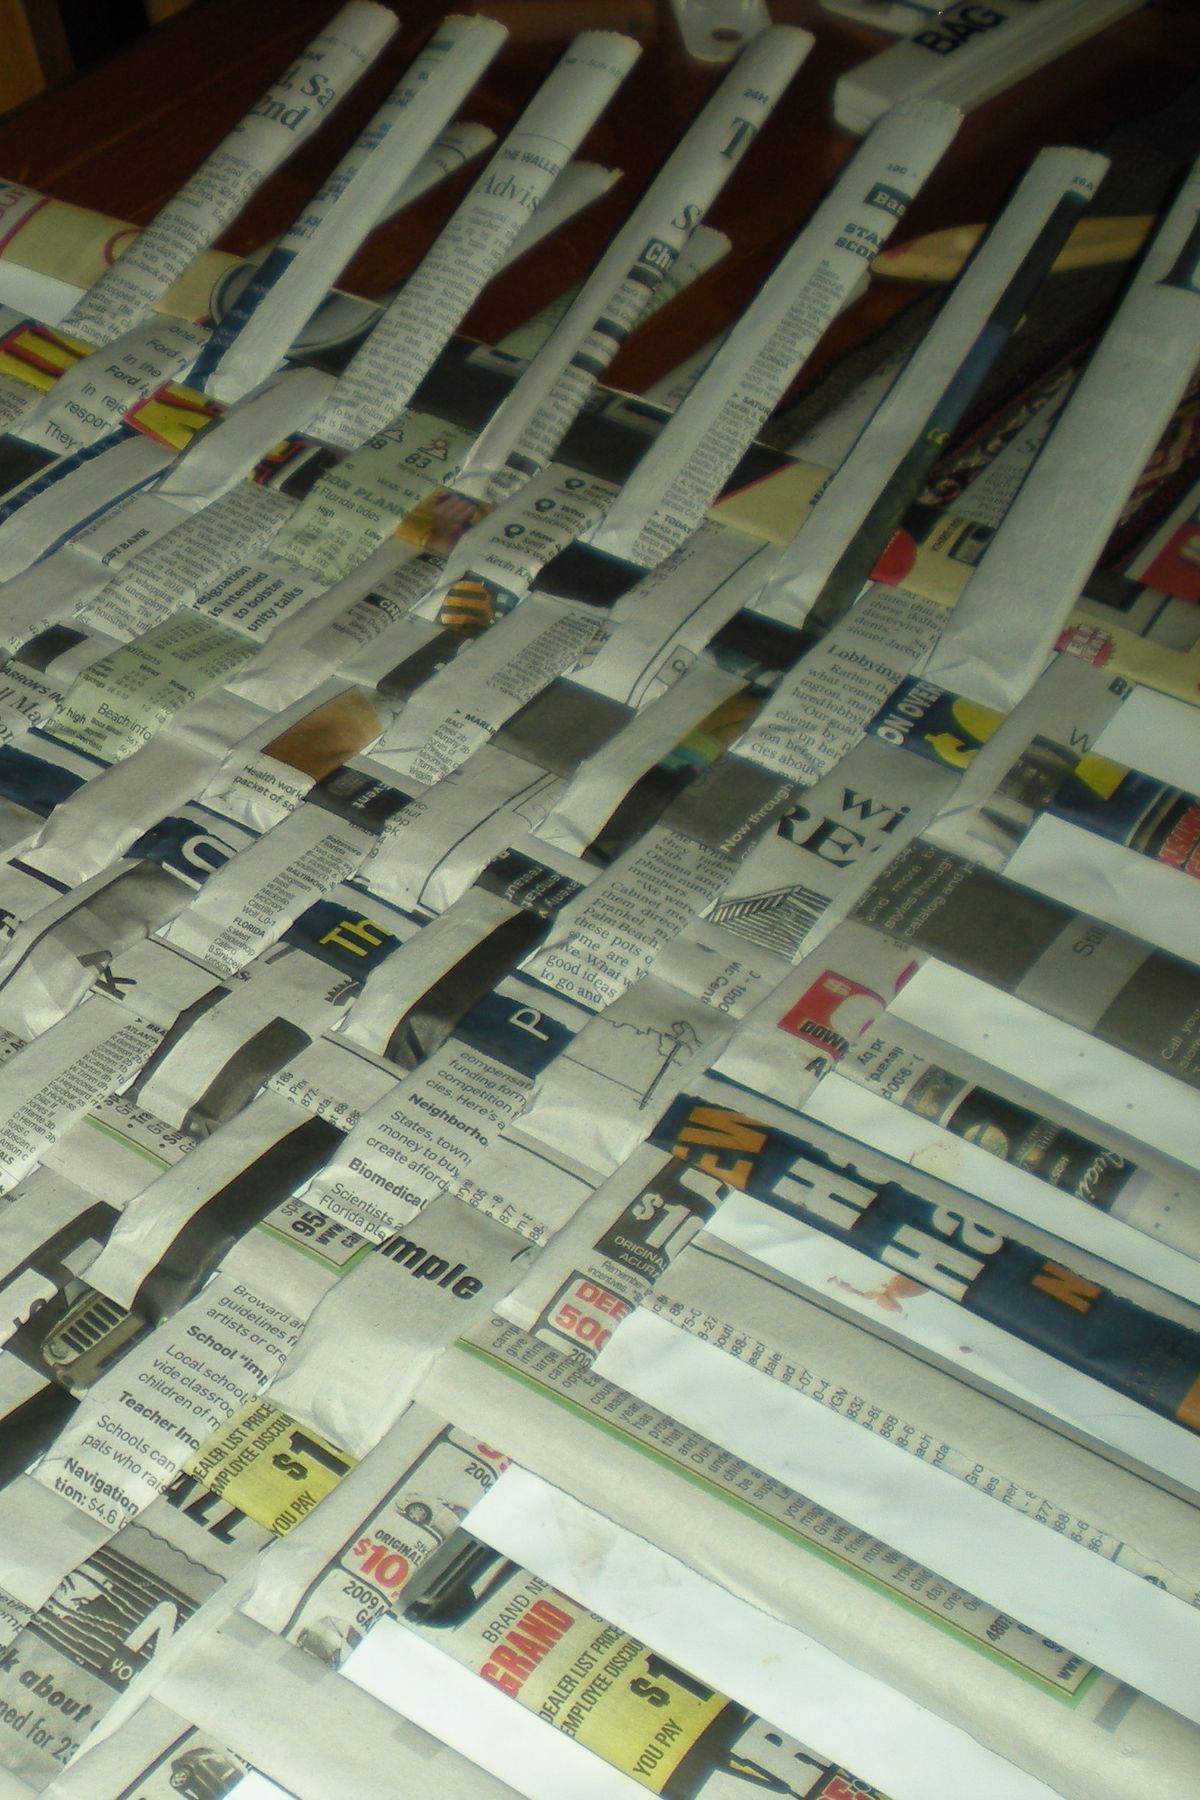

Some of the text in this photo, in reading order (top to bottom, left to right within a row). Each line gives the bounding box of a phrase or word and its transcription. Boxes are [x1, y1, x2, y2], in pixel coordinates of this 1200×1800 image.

[914, 3, 1009, 55] BAG
[481, 172, 540, 213] Advis
[122, 353, 163, 379] In the
[145, 338, 179, 360] Ford
[81, 382, 95, 397] In
[104, 365, 140, 387] Ford
[405, 451, 432, 468] 83
[318, 485, 356, 511] Florida
[192, 564, 251, 611] resignation
[208, 571, 270, 617] is intended
[232, 578, 286, 621] to bolster
[246, 587, 304, 633] unity talks
[827, 643, 902, 685] Lobbying
[830, 664, 876, 688] Rather
[808, 669, 882, 706] what comes
[65, 704, 86, 724] high
[98, 702, 153, 741] Beach info
[775, 710, 839, 743] clients by
[876, 713, 915, 745] ON
[242, 763, 278, 787] Health
[778, 752, 816, 776] about
[232, 774, 284, 804] packet of
[720, 783, 795, 852] Now through
[628, 866, 688, 897] members
[646, 851, 691, 877] Obama
[593, 898, 645, 929] Frankel,
[610, 881, 662, 910] Cabinet
[232, 916, 266, 938] FLORIDA
[574, 916, 641, 957] these pots
[583, 907, 660, 951] Palm Beach.
[904, 896, 946, 937] catalog
[606, 950, 629, 968] are
[1072, 924, 1110, 960] Still
[540, 968, 603, 1004] to go and
[546, 954, 617, 998] good ideas
[510, 1007, 551, 1042] P
[424, 1077, 498, 1125] cies. Here's
[437, 1068, 514, 1115] competition
[377, 1121, 439, 1162] money to
[389, 1109, 435, 1143] States,
[366, 1136, 412, 1167] create
[347, 1157, 428, 1211] Biomedical
[318, 1193, 368, 1228] Florida
[330, 1183, 396, 1228] Scientists
[217, 1295, 287, 1341] guidelines
[231, 1283, 290, 1324] Broward
[186, 1324, 238, 1361] School
[205, 1306, 268, 1347] artists or
[152, 1357, 182, 1383] vide
[164, 1343, 208, 1373] Local
[117, 1390, 179, 1436] Teacher
[138, 1371, 209, 1422] children of
[80, 1433, 144, 1477] pals who
[96, 1414, 177, 1474] Schools can
[220, 1424, 249, 1452] LIST
[53, 1476, 118, 1525] tion: $4.6
[63, 1456, 141, 1515] Navigation
[270, 1490, 319, 1540] YOU PAY
[373, 1528, 422, 1567] ORIGINAL
[480, 1592, 531, 1645] BRAND
[478, 1599, 576, 1701] GRAND
[19, 1665, 89, 1723] about
[537, 1645, 601, 1725] DEALER LIST
[559, 1670, 613, 1740] EMPLOYEE
[29, 1714, 61, 1751] for
[631, 1717, 685, 1779] YOU PAY
